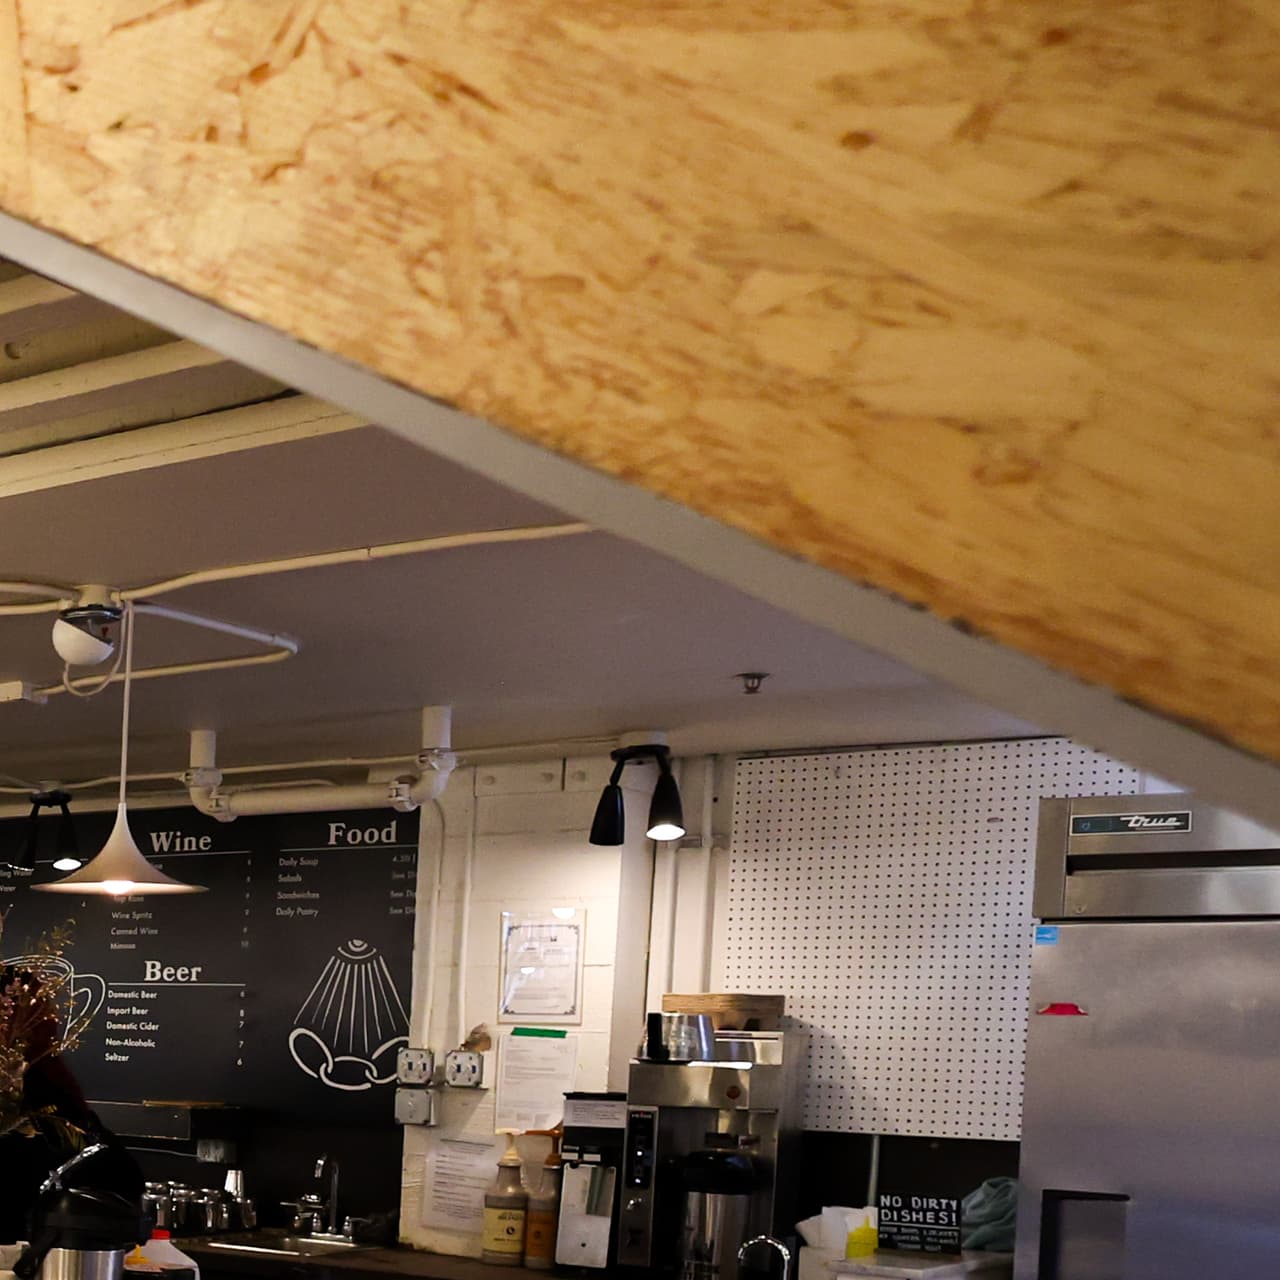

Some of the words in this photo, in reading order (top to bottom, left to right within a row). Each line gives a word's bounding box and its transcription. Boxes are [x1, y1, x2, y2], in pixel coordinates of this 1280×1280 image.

[328, 820, 397, 845] Food
[150, 831, 212, 852] Wine
[112, 911, 130, 919] Wine
[111, 927, 138, 935] Canned
[144, 960, 202, 981] Beer
[108, 990, 139, 999] Domestic
[141, 990, 158, 999] Beer
[107, 1006, 130, 1016] Import
[132, 1006, 149, 1015] Beer
[106, 1021, 138, 1030] Domestic
[140, 1021, 160, 1031] Cider
[105, 1037, 156, 1048] Non-Alcoholic
[105, 1052, 130, 1062] Seltzer
[880, 1194, 902, 1208] NO
[912, 1196, 958, 1211] DIRTY
[880, 1209, 957, 1226] DISHES!
